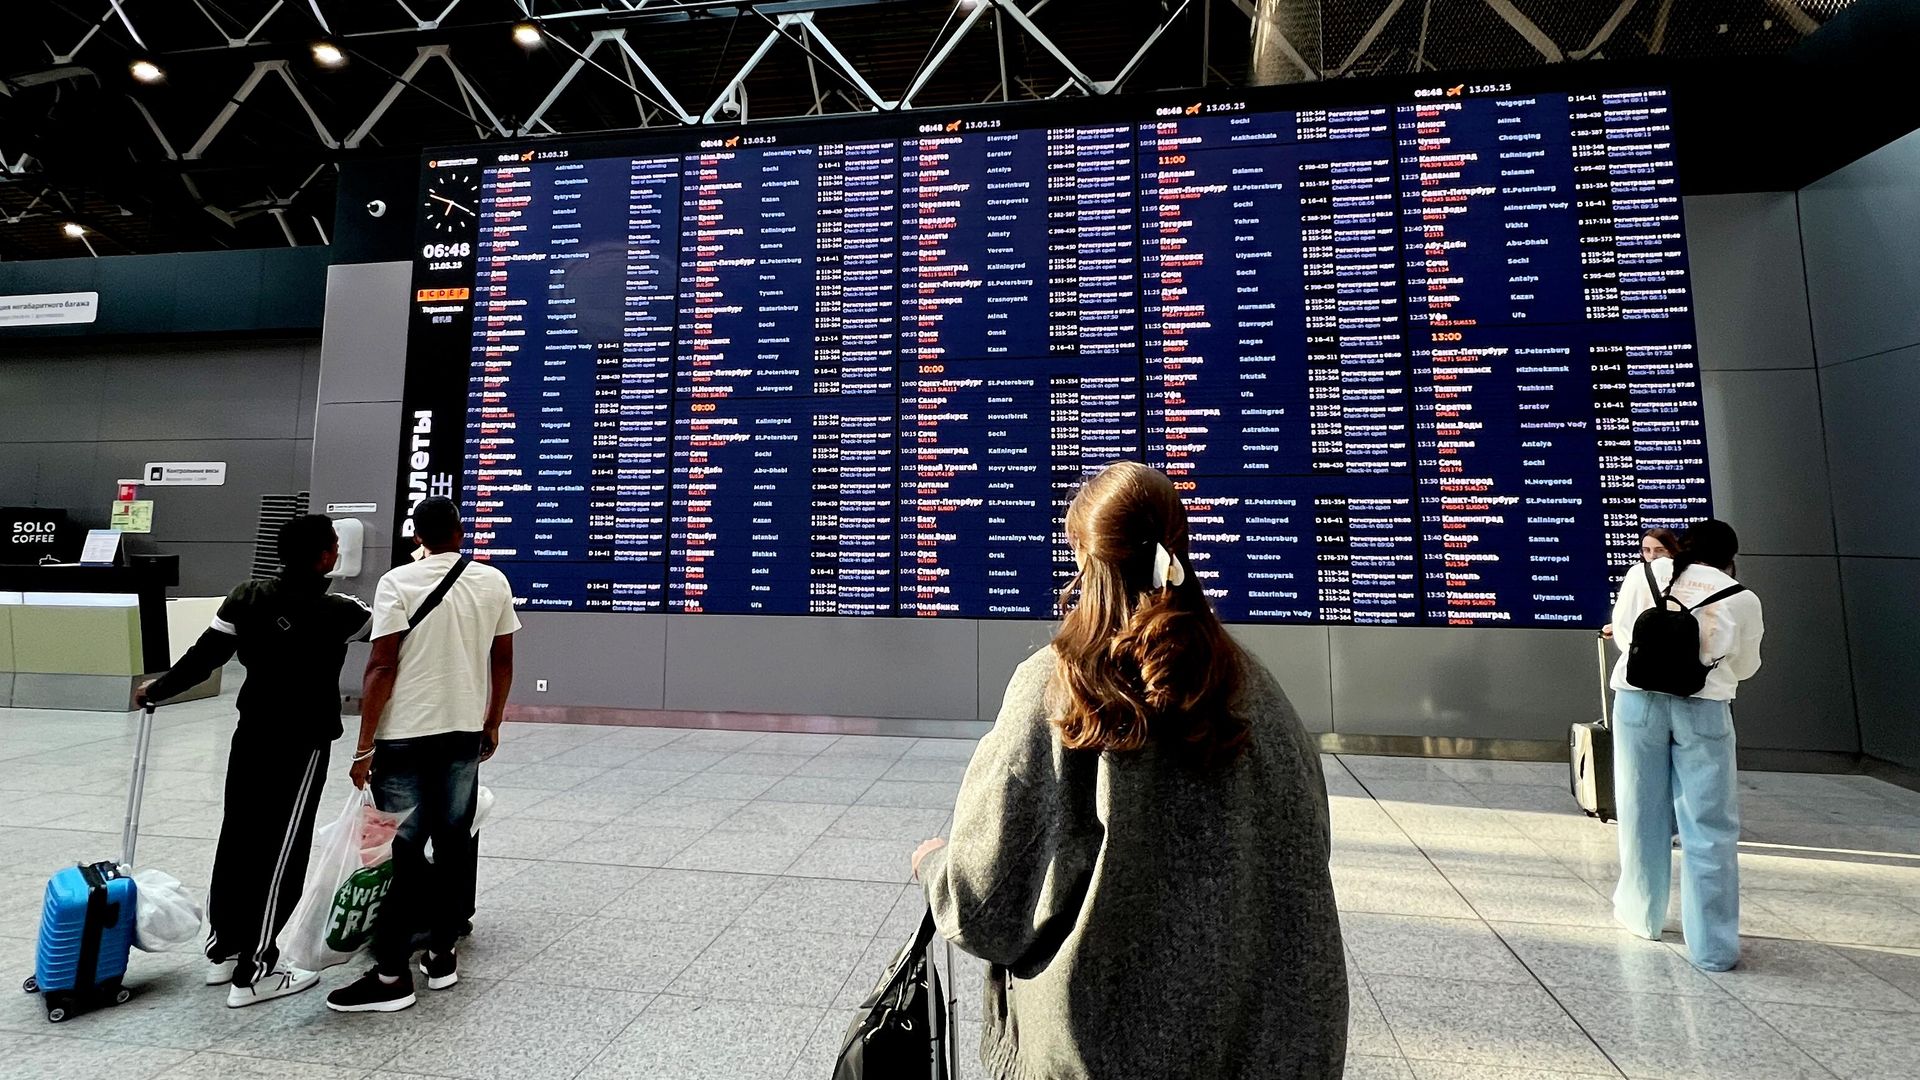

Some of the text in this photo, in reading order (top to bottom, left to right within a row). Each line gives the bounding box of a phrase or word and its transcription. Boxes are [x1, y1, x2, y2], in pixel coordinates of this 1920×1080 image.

[1159, 156, 1185, 164] 11:00
[423, 243, 471, 258] 06:48
[429, 261, 462, 270] 13.05.25
[1432, 333, 1462, 341] 13:00
[919, 365, 944, 373] 10:00
[1173, 482, 1196, 490] 2:00
[13, 522, 56, 533] SOLO
[12, 535, 54, 543] COFFEE
